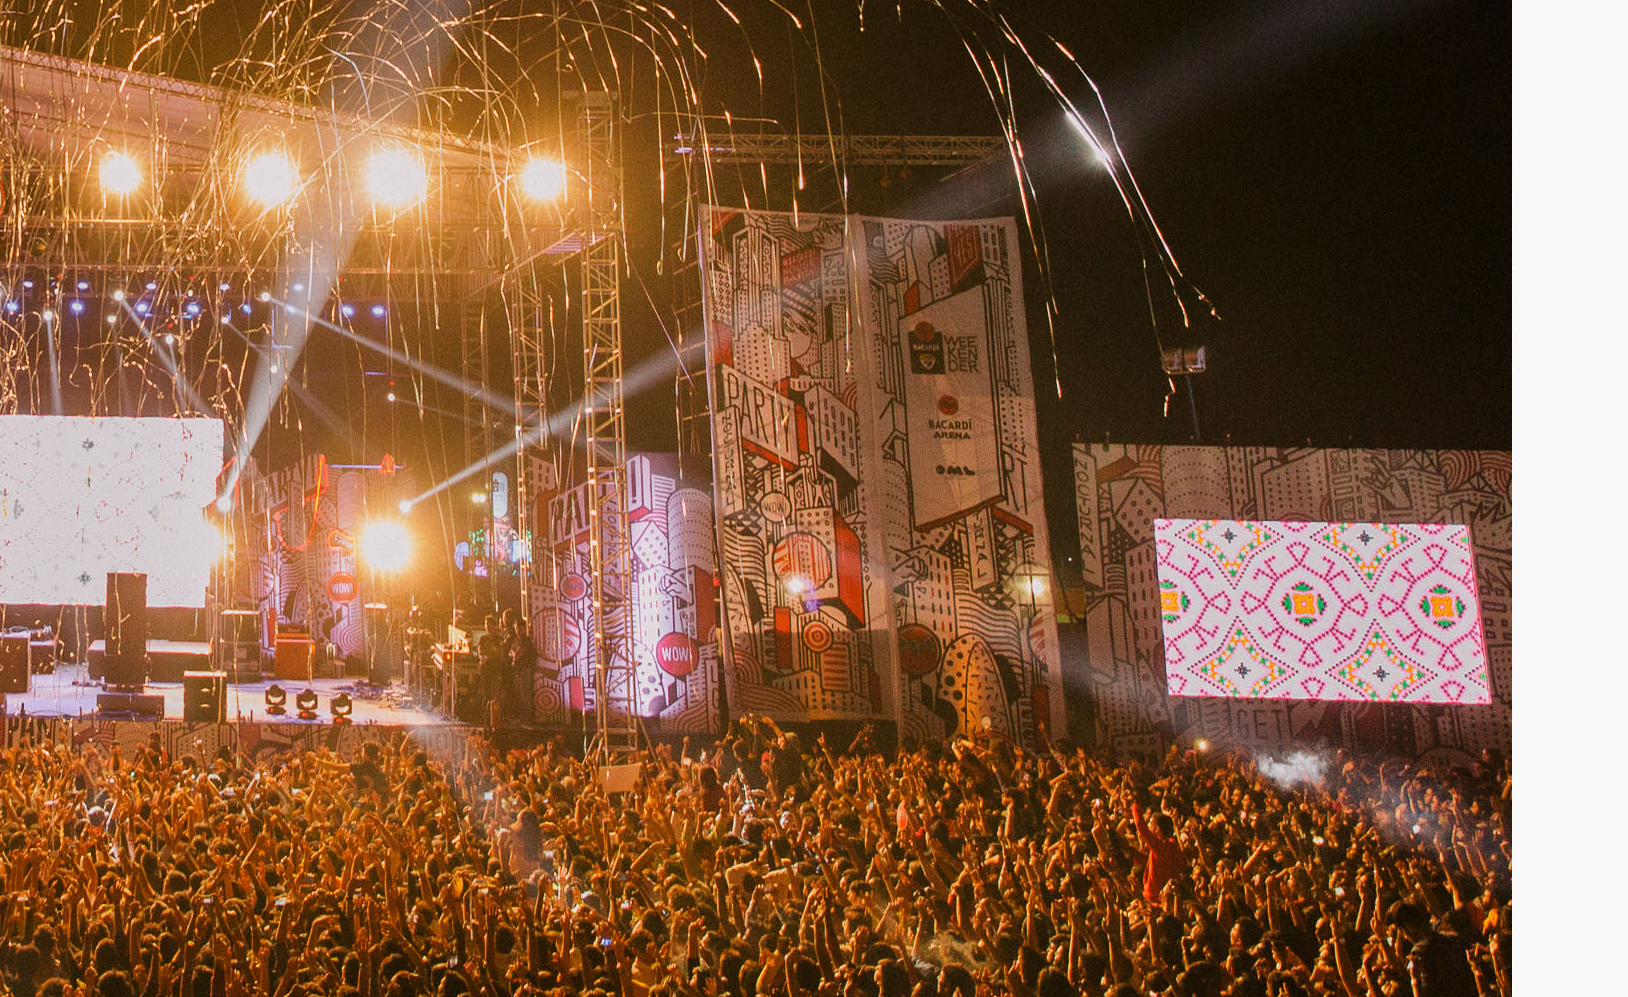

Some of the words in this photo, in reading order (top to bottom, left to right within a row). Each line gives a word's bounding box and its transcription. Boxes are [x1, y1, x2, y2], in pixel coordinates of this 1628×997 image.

[943, 334, 978, 347] WEE
[947, 348, 979, 361] KEN
[948, 360, 980, 373] DER
[727, 371, 790, 453] PARTY
[928, 418, 973, 431] BACARDÍ
[933, 431, 971, 440] ARENA
[1074, 456, 1096, 575] NOCTURNAL
